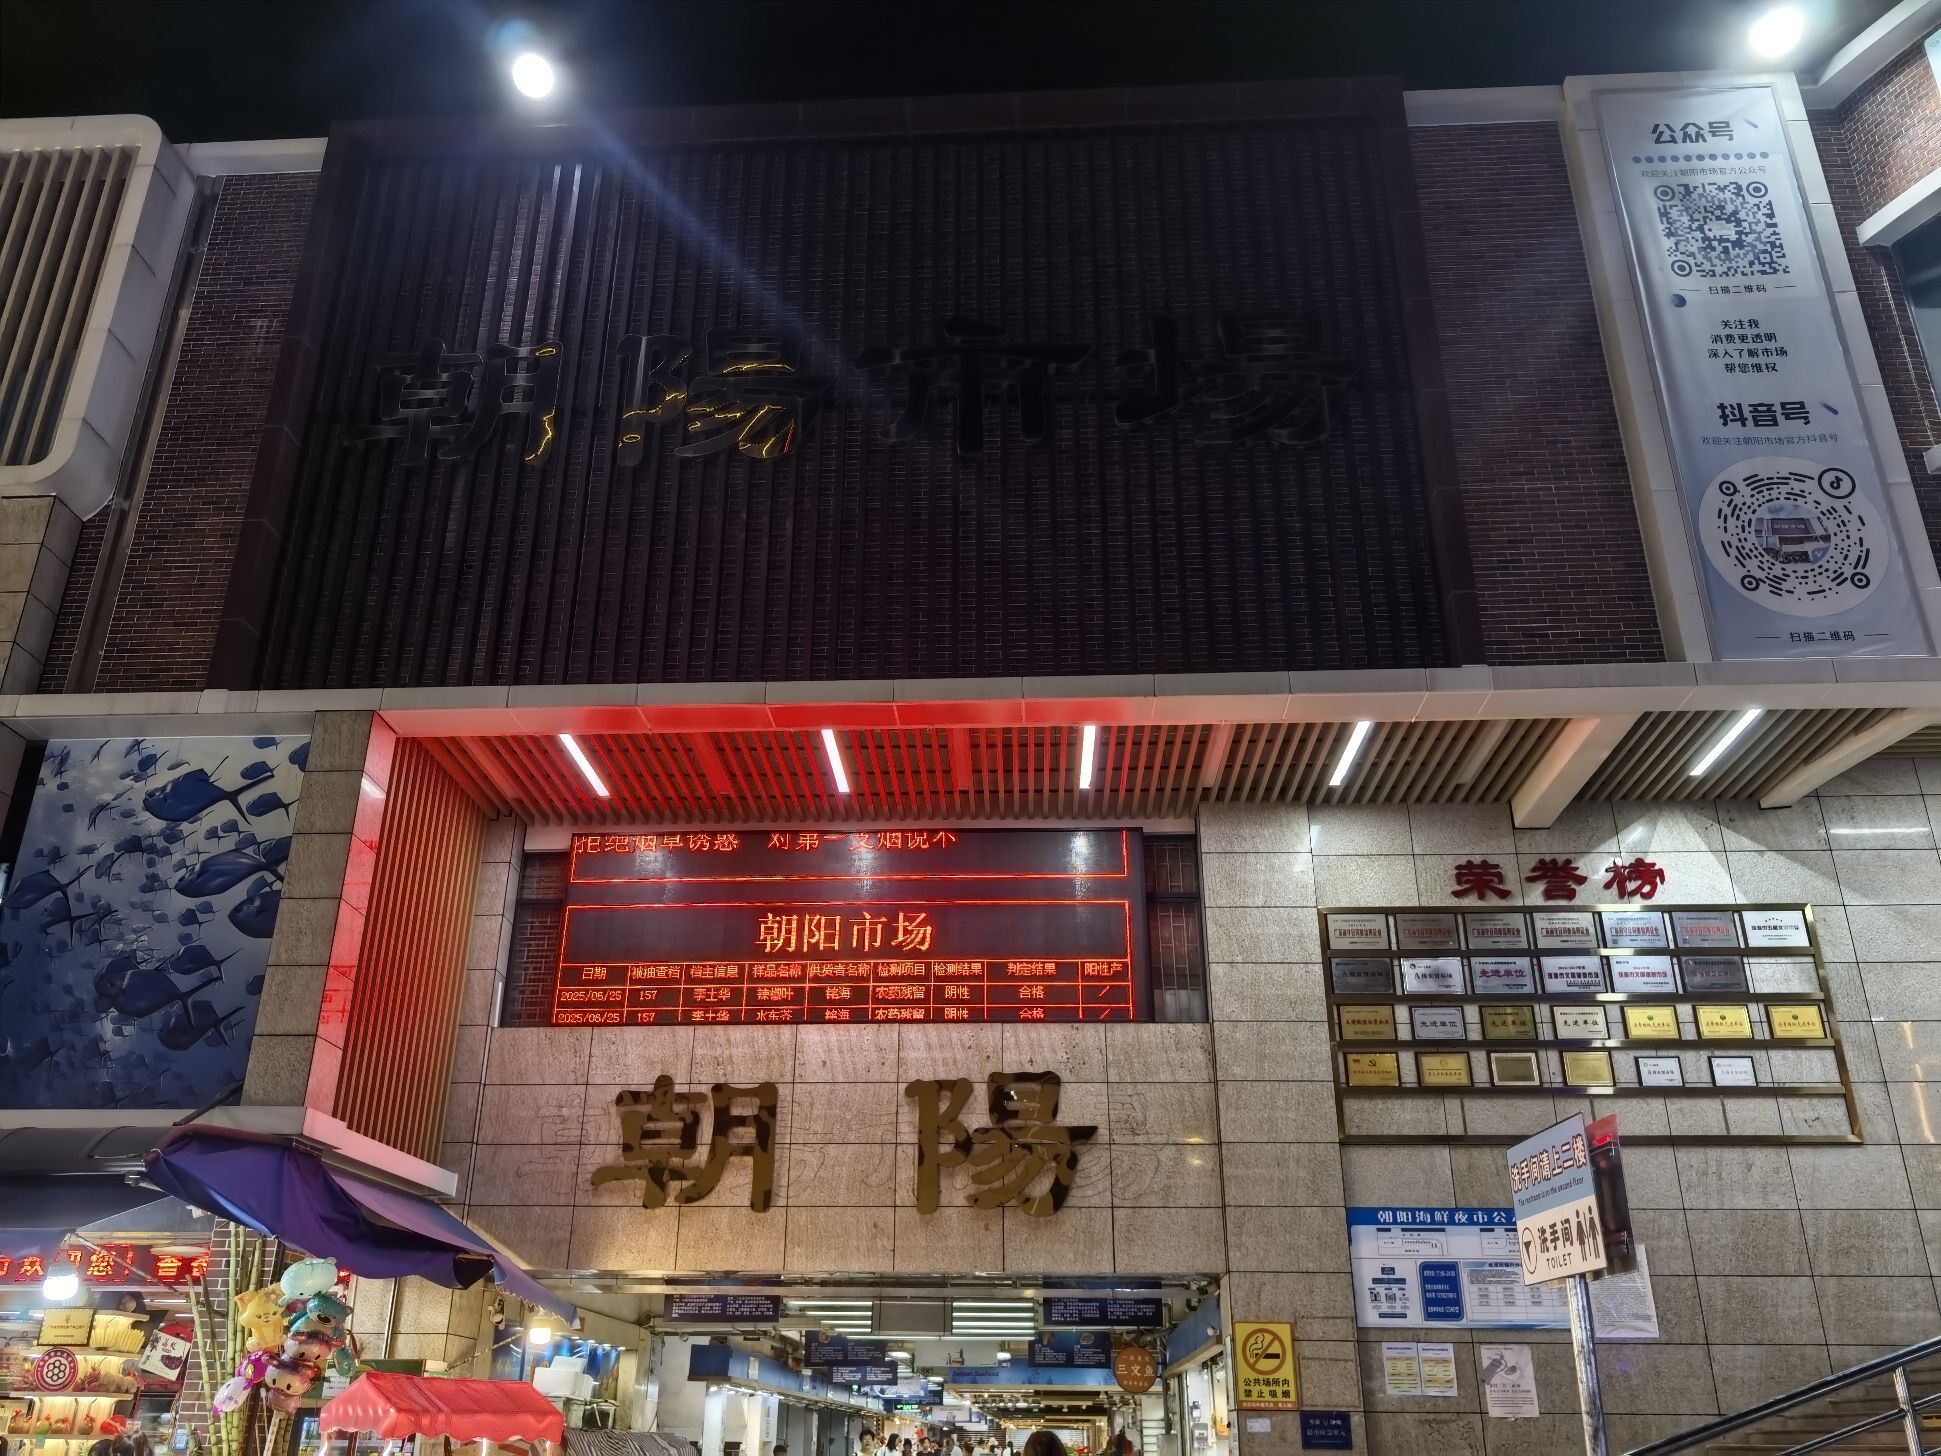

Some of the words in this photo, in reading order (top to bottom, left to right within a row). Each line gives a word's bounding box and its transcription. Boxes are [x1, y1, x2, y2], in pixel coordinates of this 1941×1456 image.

[1650, 120, 1734, 145] 公众号
[1708, 284, 1767, 295] 扫描二维码
[1720, 318, 1760, 330] 关注我
[1710, 332, 1778, 345] 消费更透明
[1707, 346, 1788, 359] 深入了解市场
[1724, 361, 1778, 374] 帮您维权
[1717, 400, 1811, 428] 抖音号
[1701, 433, 1839, 446] 欢迎关注朝阳市场官方抖音号
[1789, 630, 1856, 643] 扫描二维码
[1450, 857, 1665, 900] 荣誉榜
[756, 911, 933, 953] 朝阳市场
[582, 966, 607, 980] 日期
[690, 965, 739, 979] 档主信息
[752, 963, 802, 978] 样品名称
[809, 963, 871, 978] 供货者名称
[877, 962, 925, 977] 检测项目
[933, 962, 983, 976] 检测结果
[1007, 962, 1057, 976] 判定结果
[1479, 968, 1526, 978] 先进单位
[560, 990, 622, 1001] 2025/06/25
[639, 990, 658, 1000] 157
[875, 985, 926, 999] 农药残留
[945, 985, 970, 999] 阴性
[1019, 984, 1045, 999] 合格
[558, 1012, 620, 1023] 2025/06/25
[637, 1012, 656, 1022] 157
[1019, 1007, 1045, 1019] 合格
[1420, 1020, 1458, 1028] 先进单位
[1562, 1019, 1600, 1027] 先进单位
[1510, 1133, 1588, 1193] 洗手间请上二楼
[1378, 1210, 1516, 1224] 朝阳海鲜夜市公
[1537, 1217, 1574, 1254] 洗手间
[1546, 1252, 1572, 1272] TOILET
[1116, 1364, 1155, 1377] 三文鱼
[1243, 1378, 1290, 1388] 公共场所内
[1243, 1388, 1291, 1399] 禁止吸烟
